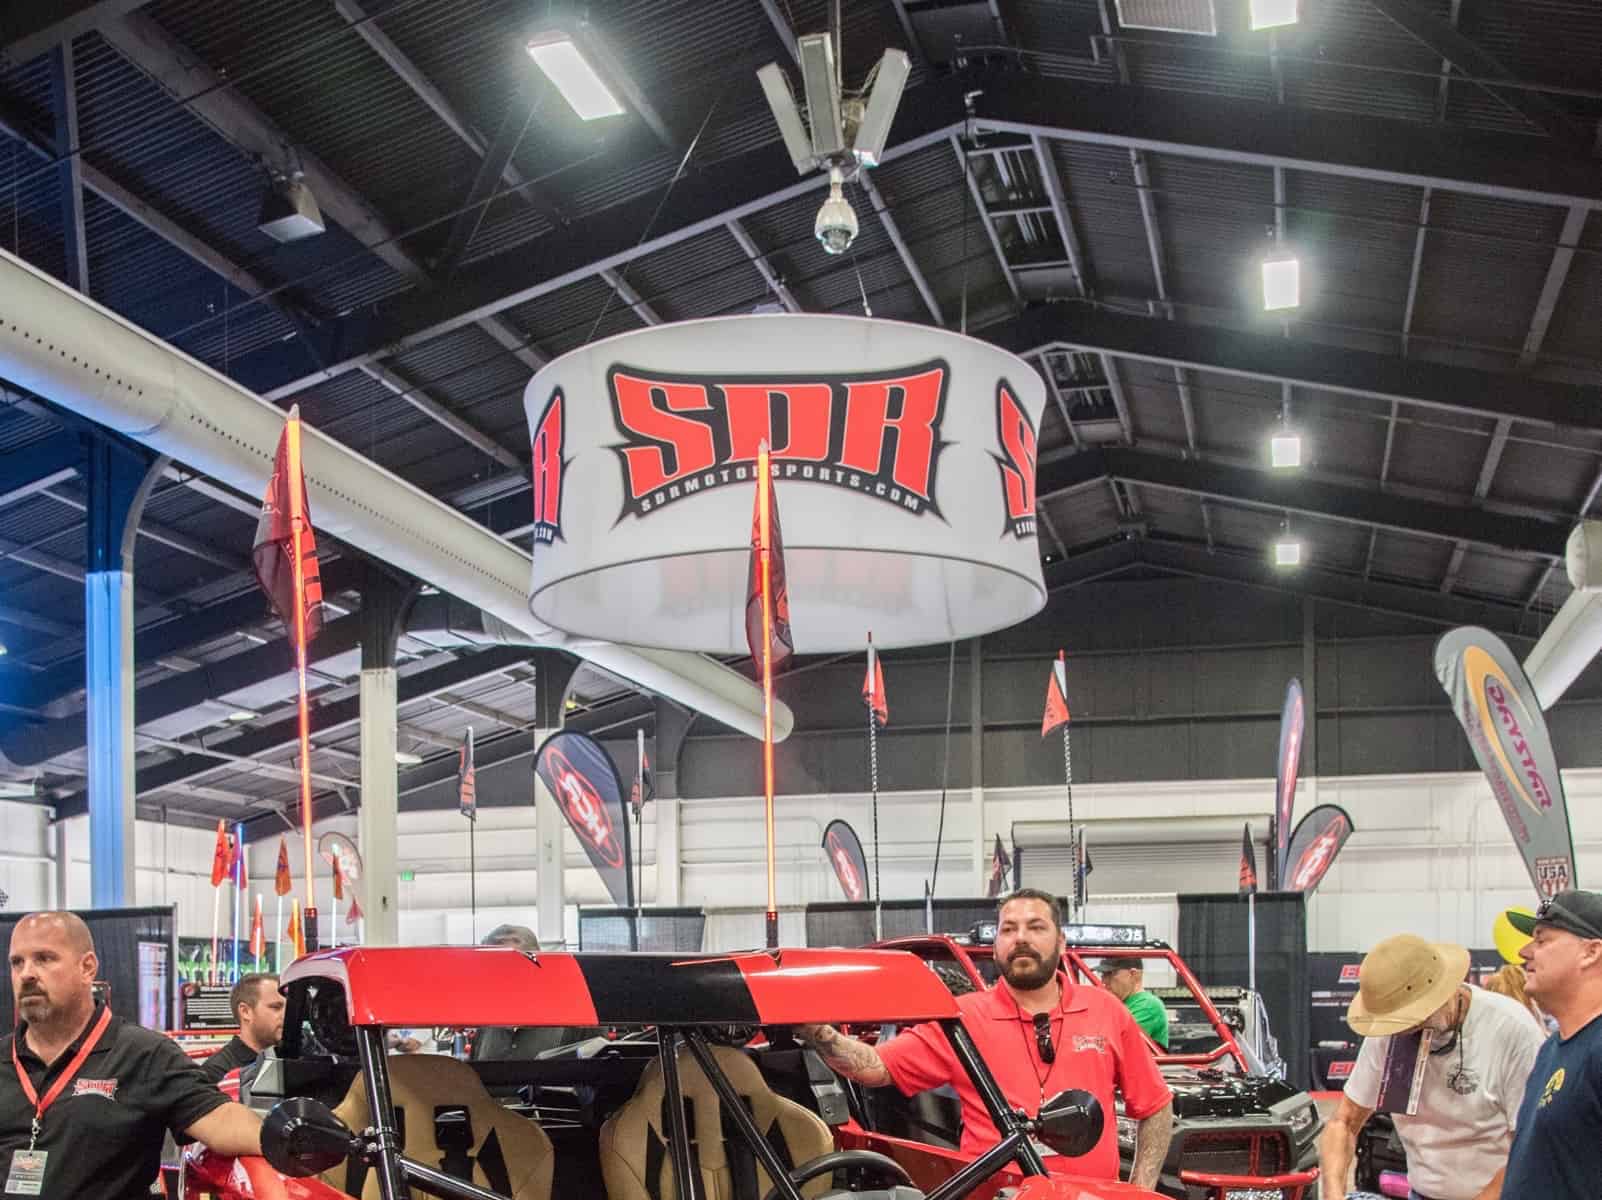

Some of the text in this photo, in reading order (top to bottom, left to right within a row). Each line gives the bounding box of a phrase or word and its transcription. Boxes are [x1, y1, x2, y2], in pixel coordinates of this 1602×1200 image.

[612, 367, 944, 502] SDR
[1487, 684, 1553, 808] DAYSTAR
[1539, 865, 1567, 879] USA
